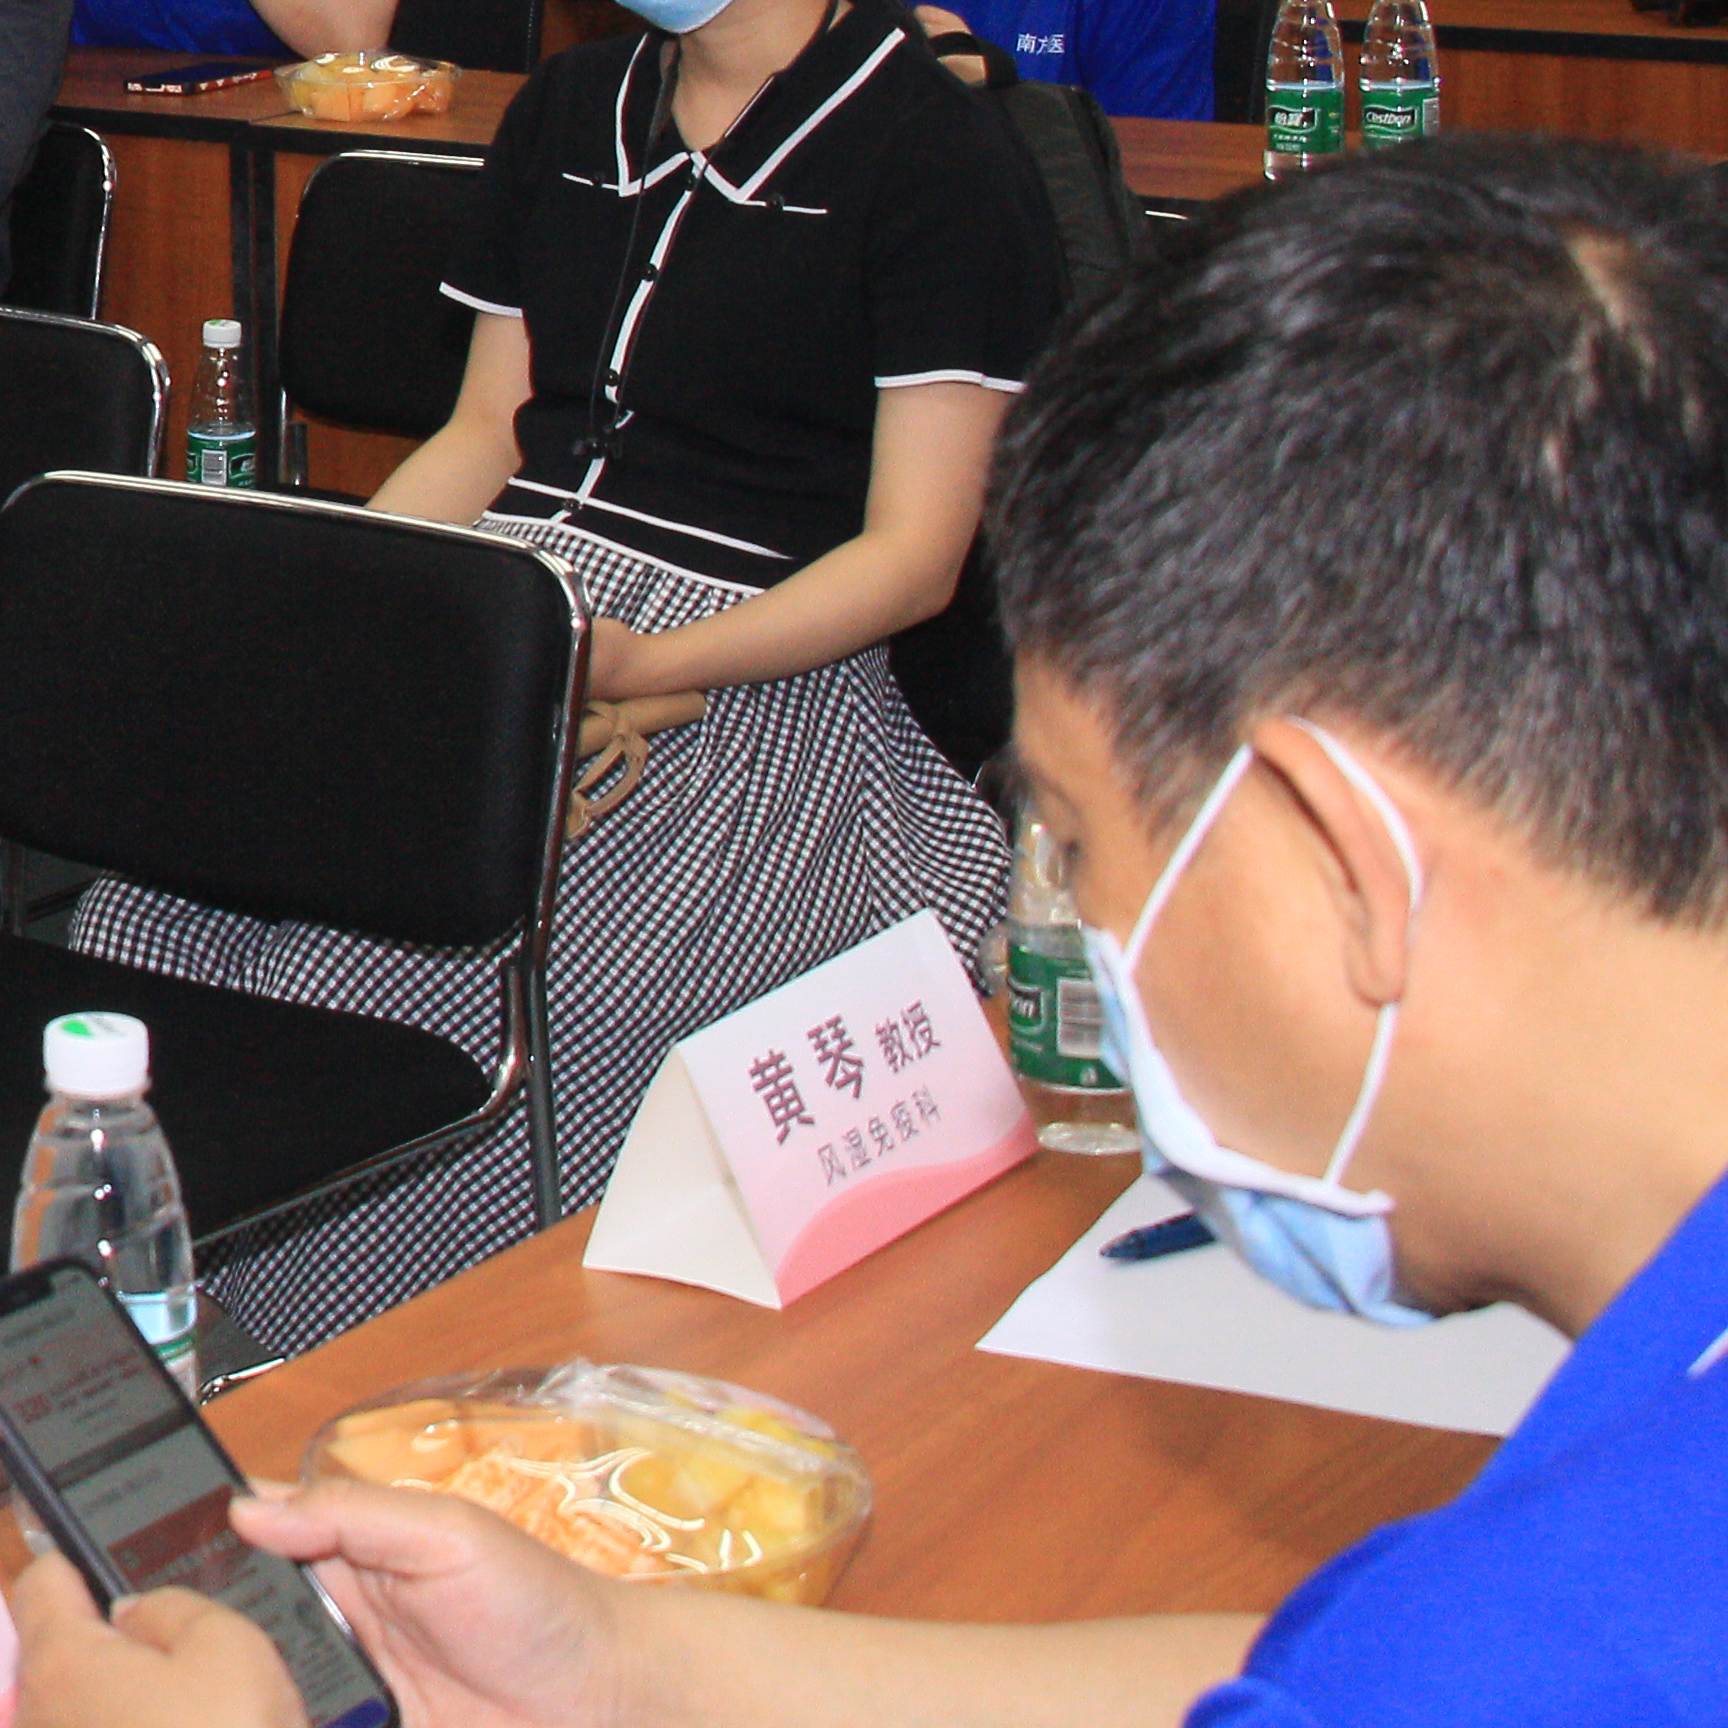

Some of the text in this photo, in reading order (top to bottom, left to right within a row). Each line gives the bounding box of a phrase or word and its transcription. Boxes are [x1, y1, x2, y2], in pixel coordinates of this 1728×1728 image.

[874, 999, 943, 1075] 教授
[815, 1083, 941, 1187] 风湿免疫科
